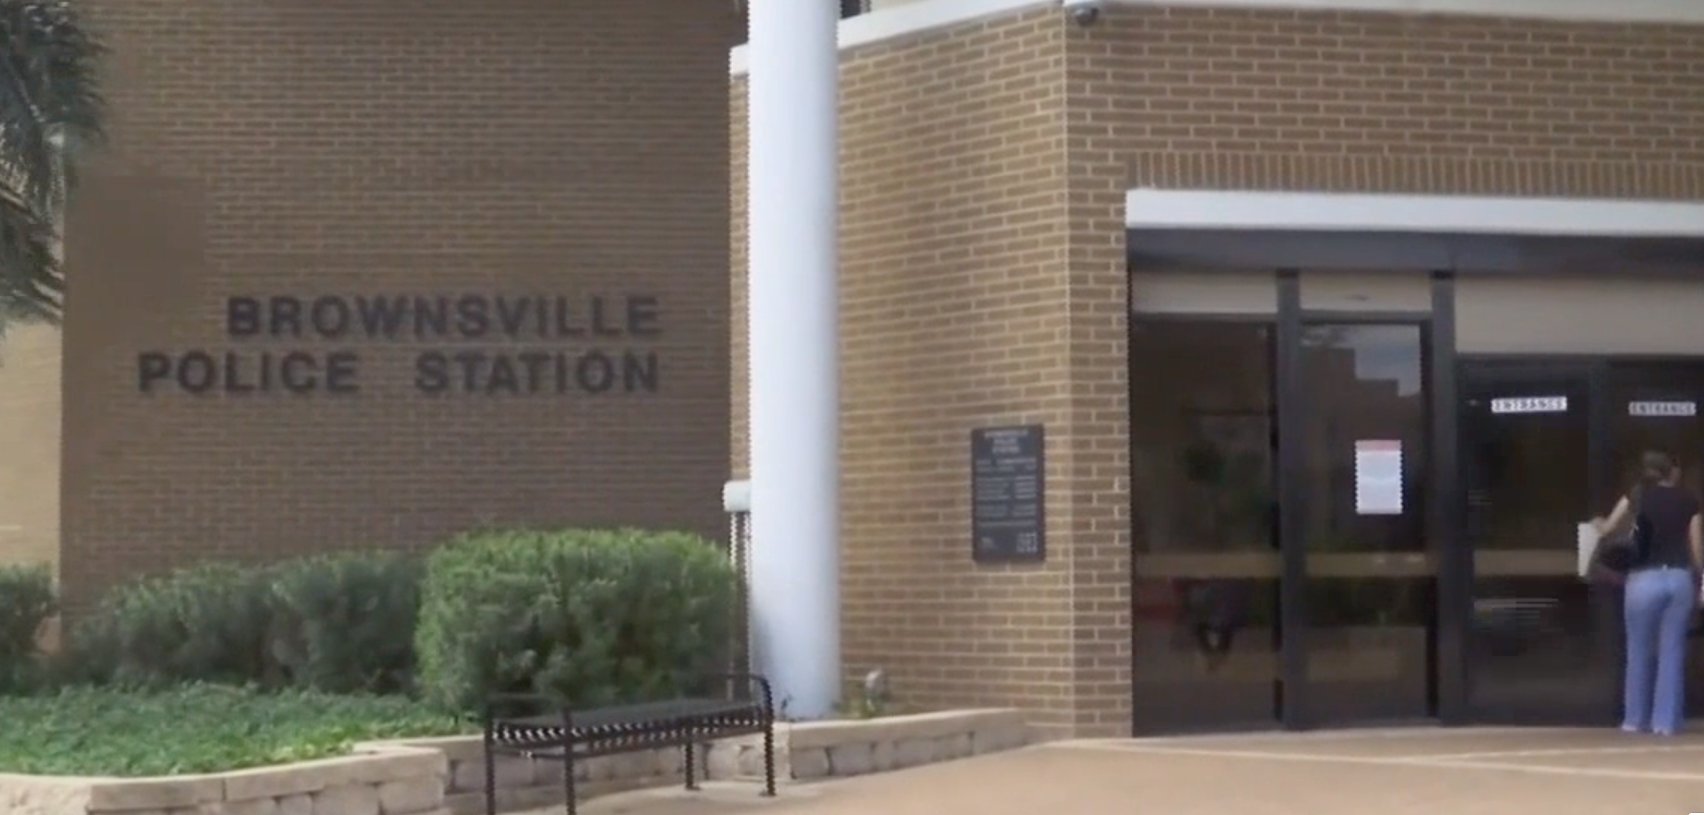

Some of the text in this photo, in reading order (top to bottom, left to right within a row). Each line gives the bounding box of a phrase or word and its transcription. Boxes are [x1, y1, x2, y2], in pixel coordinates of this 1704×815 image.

[226, 296, 663, 339] BROWNSVILLE
[137, 351, 660, 394] POLICE STATION
